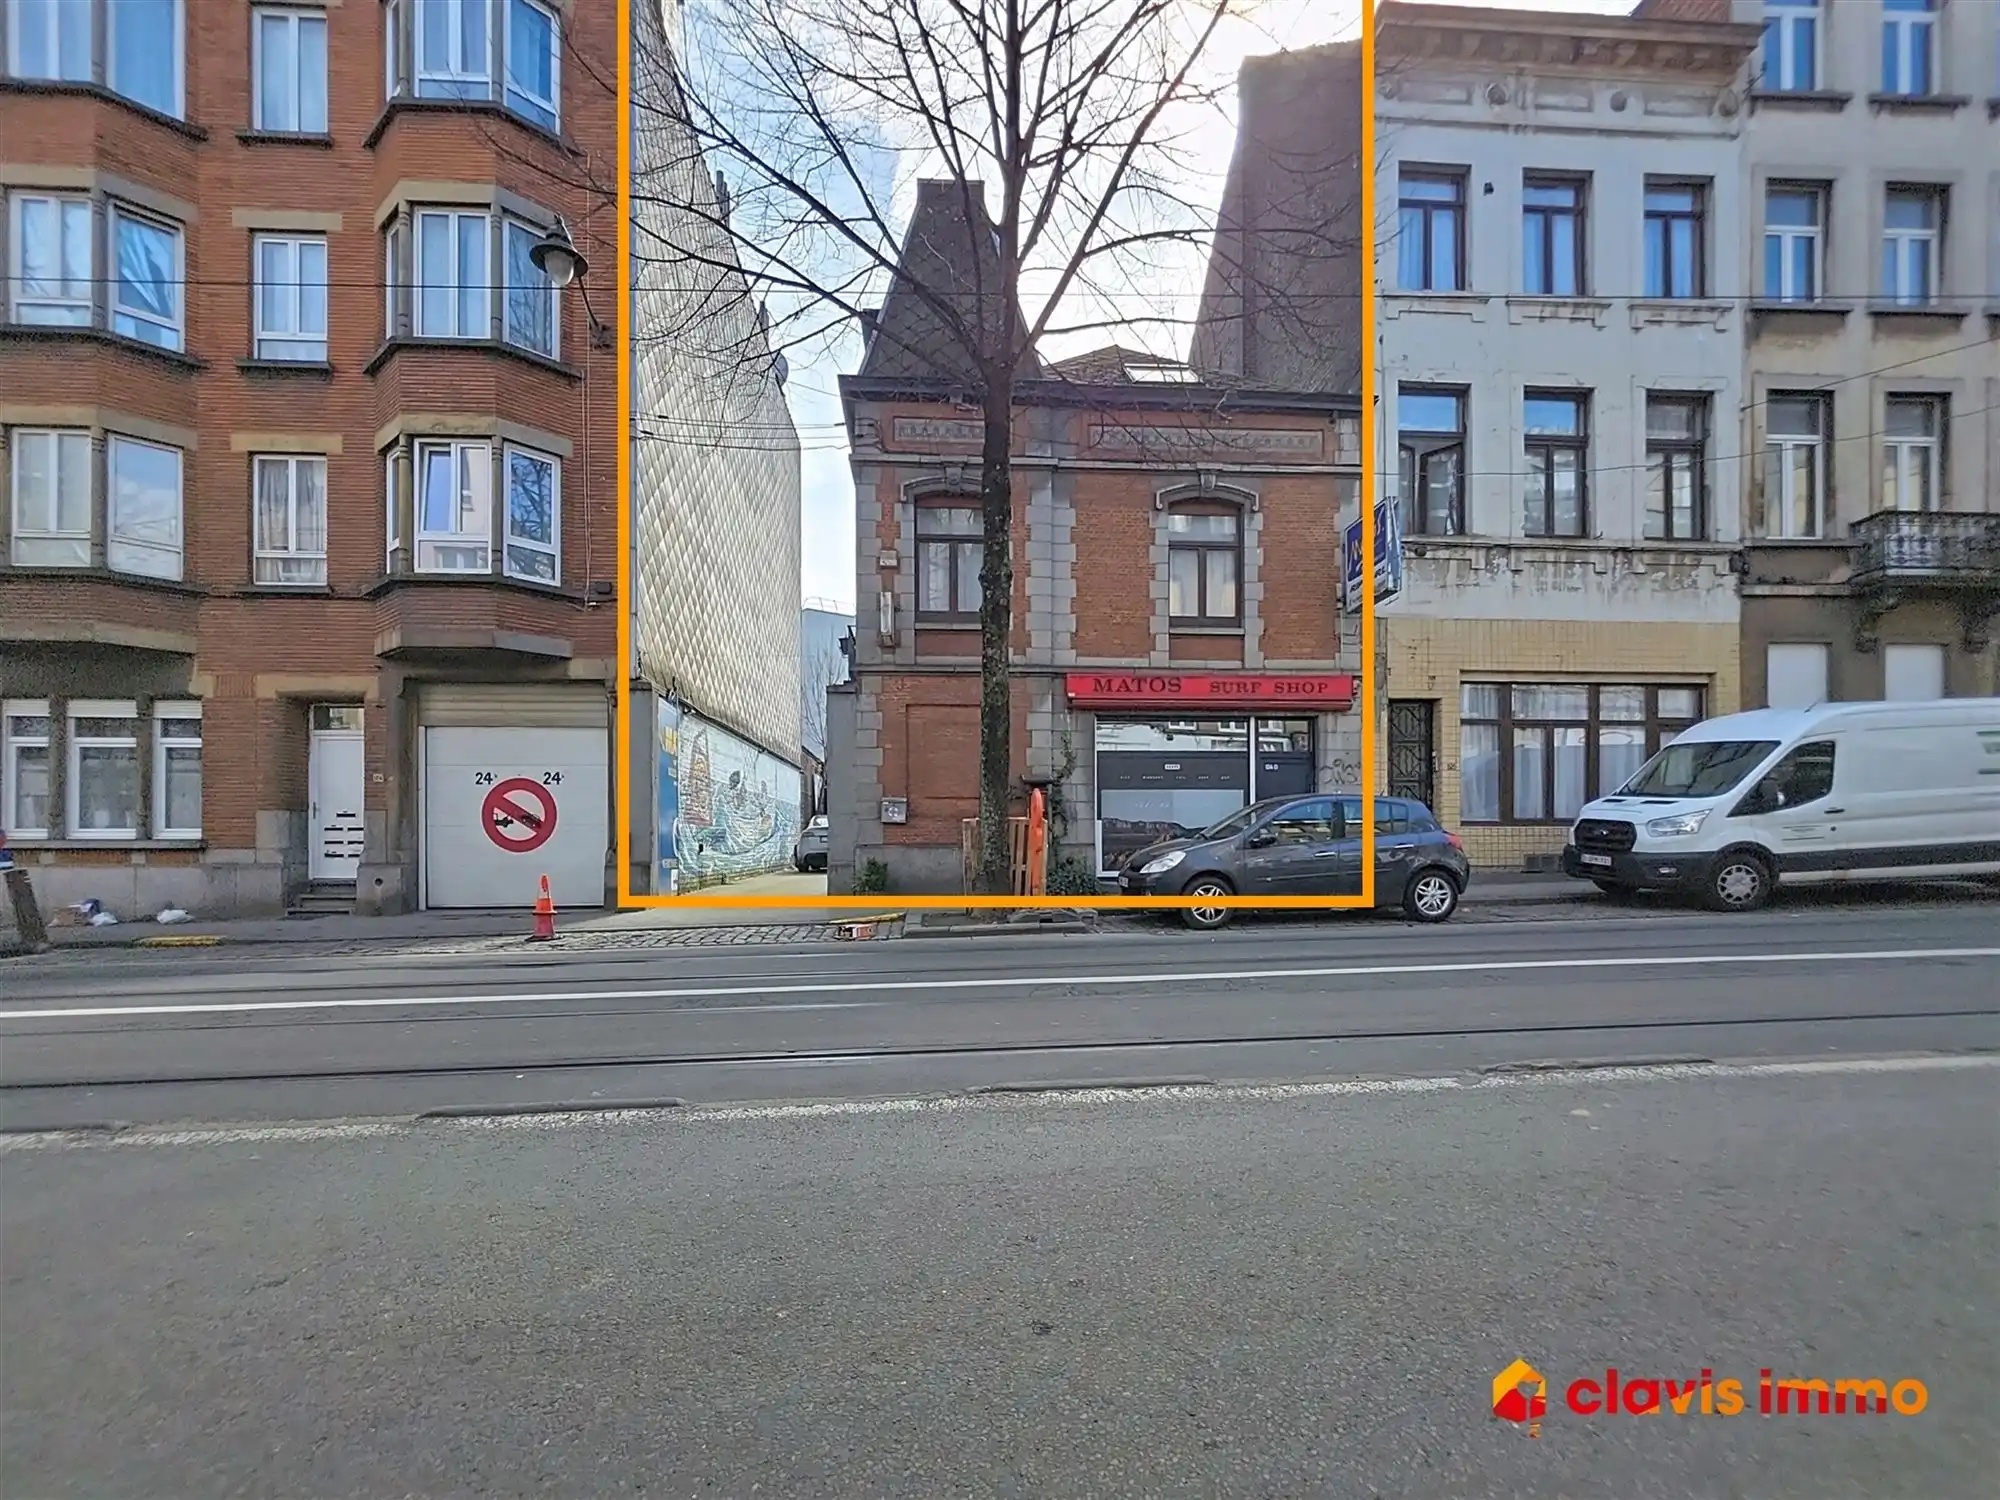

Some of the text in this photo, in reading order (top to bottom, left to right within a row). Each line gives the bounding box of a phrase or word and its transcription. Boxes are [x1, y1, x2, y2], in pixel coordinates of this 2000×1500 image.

[1093, 676, 1329, 694] MATOS SURF SHOP
